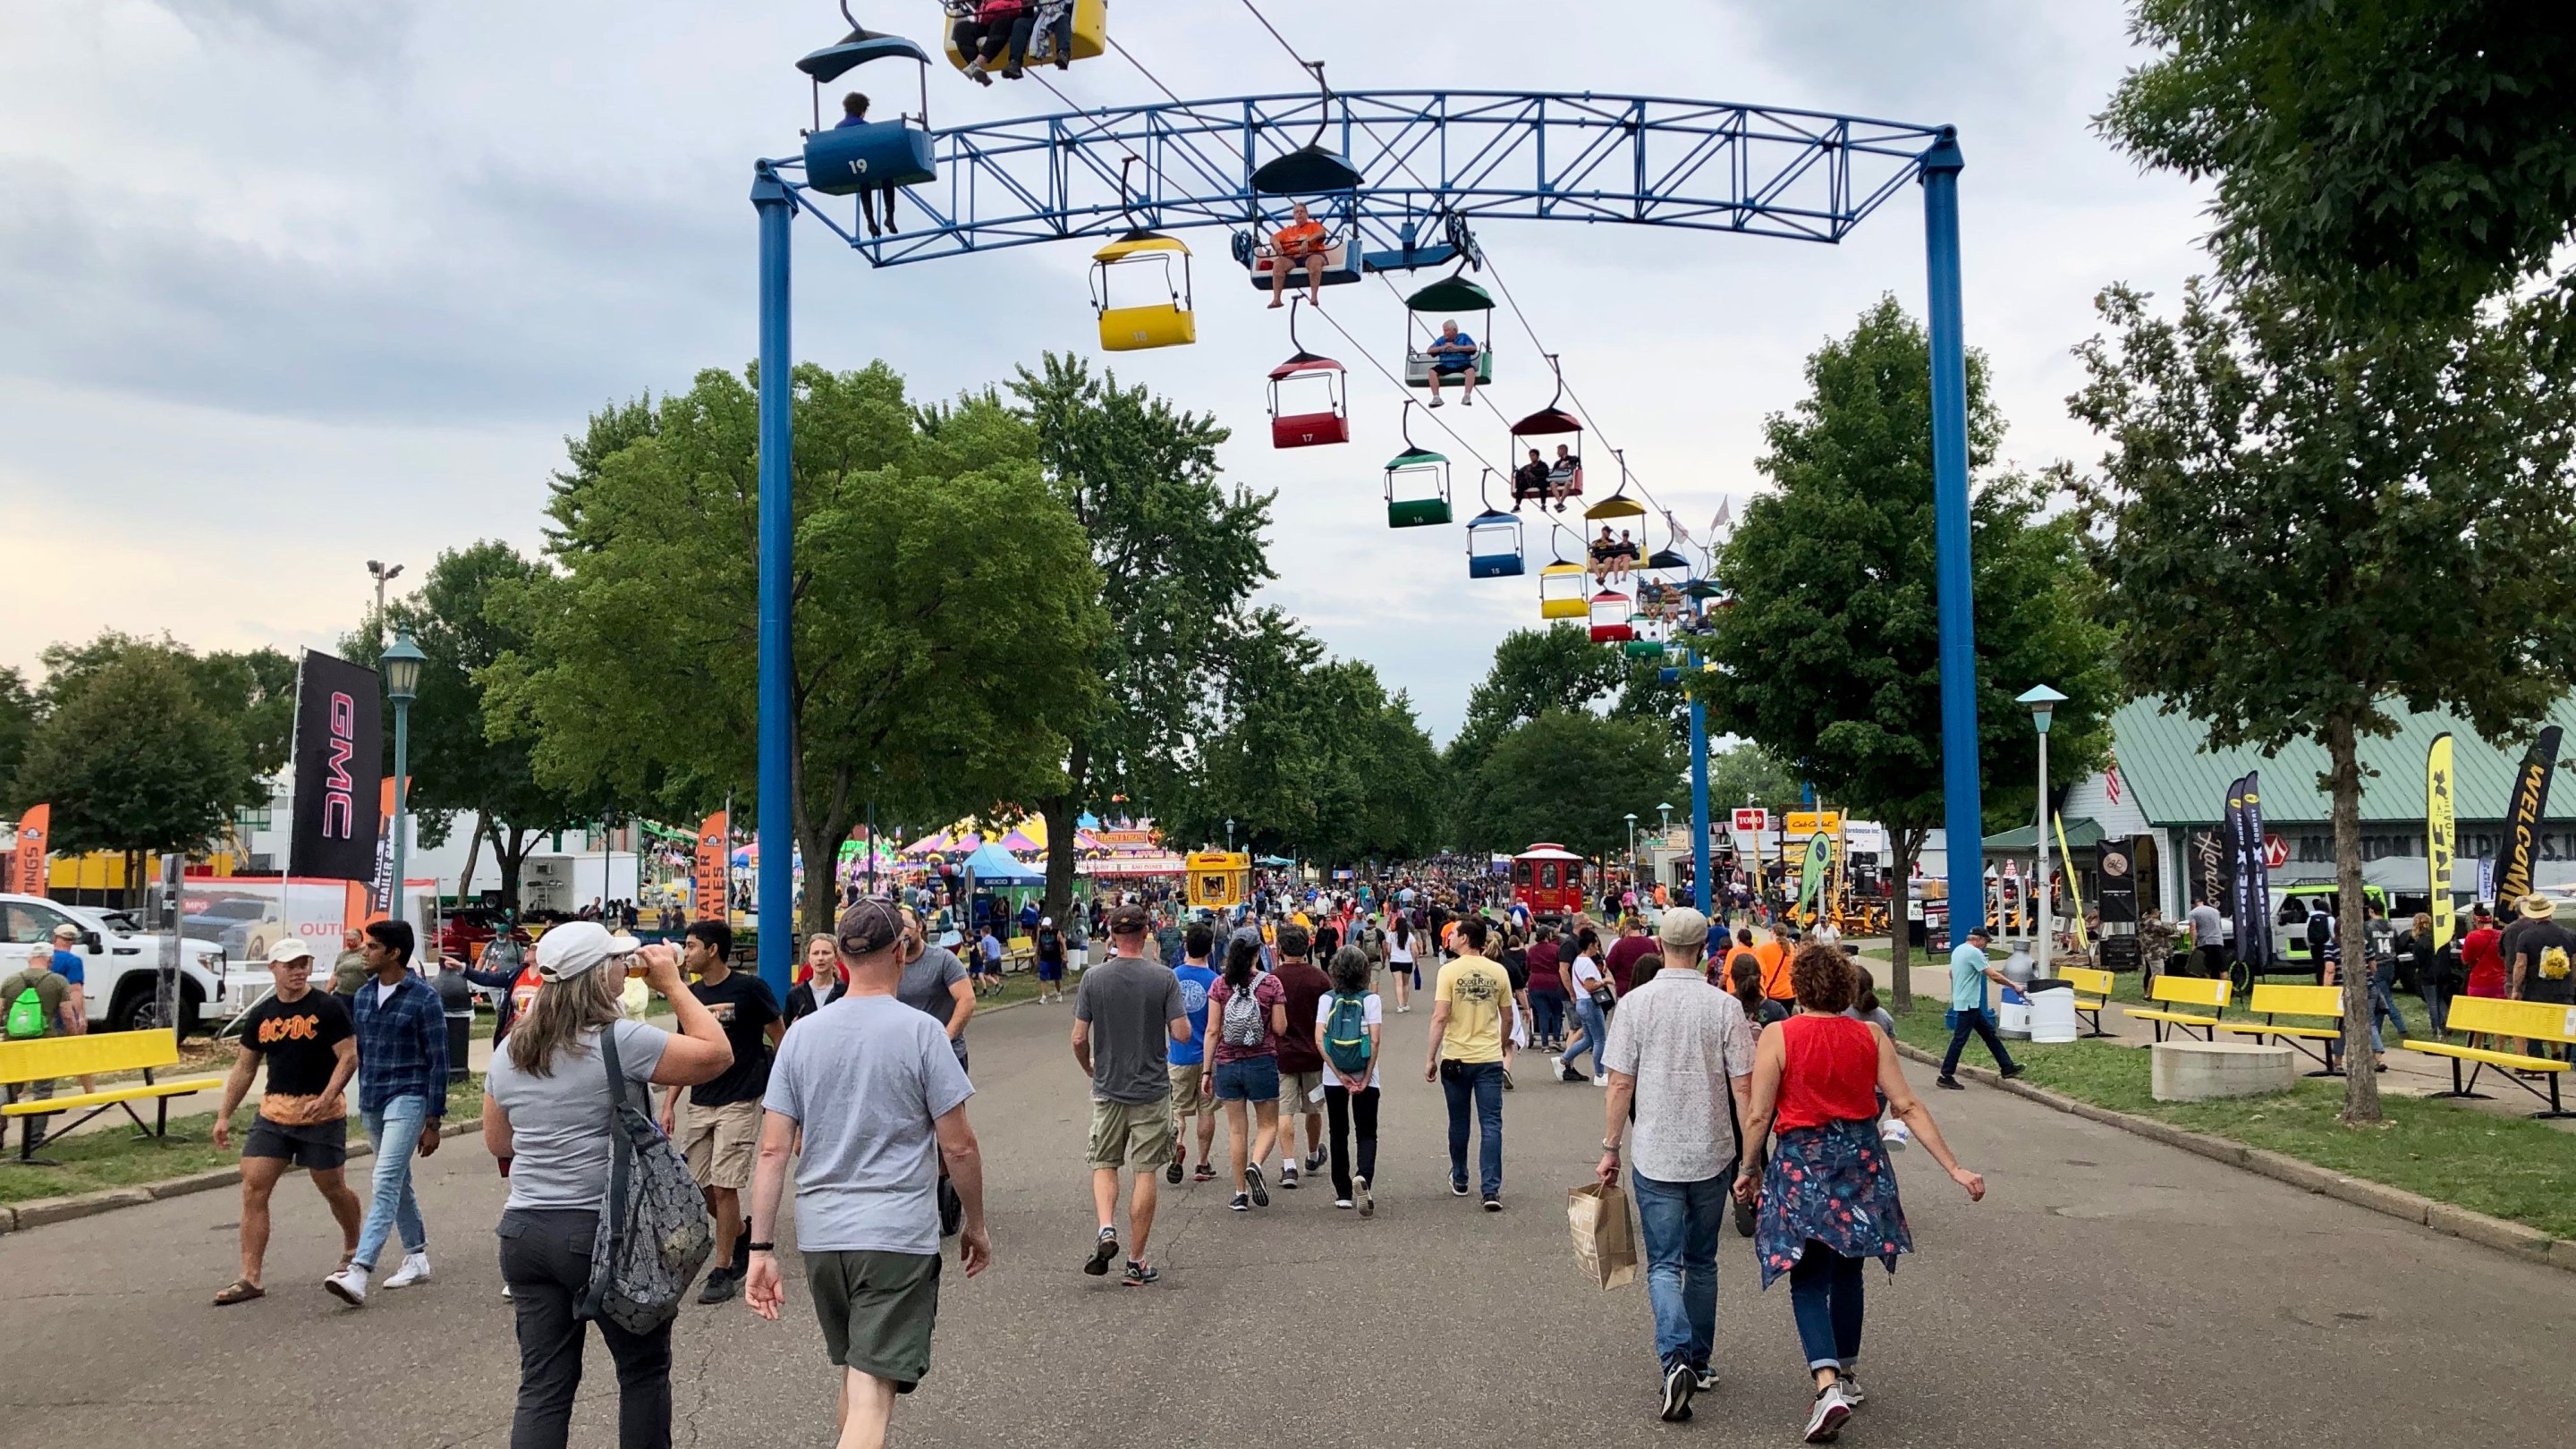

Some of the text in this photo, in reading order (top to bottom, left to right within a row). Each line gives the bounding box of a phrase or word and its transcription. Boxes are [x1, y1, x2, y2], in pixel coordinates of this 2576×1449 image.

[848, 157, 868, 174] 19
[1301, 433, 1314, 443] 17
[1413, 515, 1424, 524] 16
[322, 691, 355, 840] GMC
[1792, 820, 1808, 828] Cub
[2497, 762, 2546, 912] WELCOME
[2299, 835, 2412, 862] MOTON
[379, 860, 394, 910] TRAILER
[185, 901, 208, 910] MPG
[2377, 938, 2392, 953] 14
